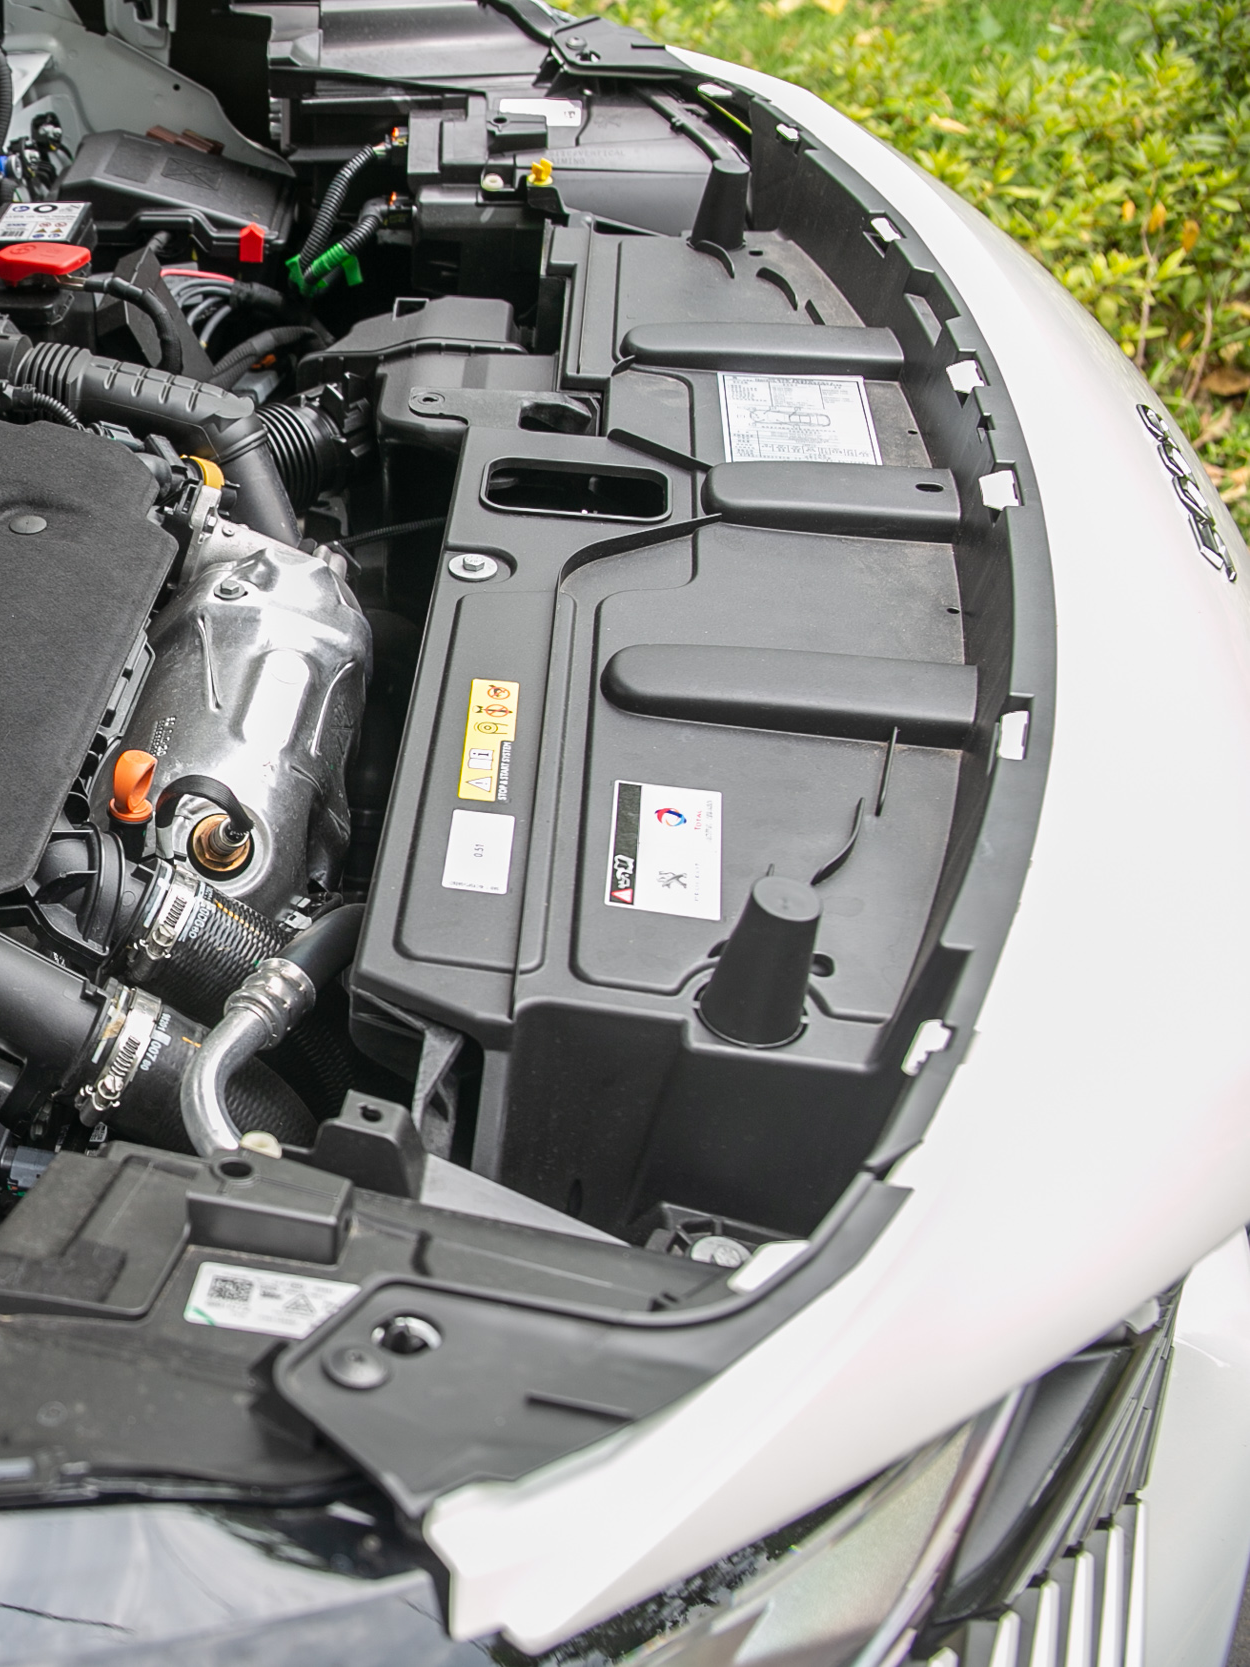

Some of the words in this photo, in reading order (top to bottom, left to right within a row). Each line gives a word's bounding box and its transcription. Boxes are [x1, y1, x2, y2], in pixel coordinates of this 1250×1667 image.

[501, 741, 512, 762] SYSTEM
[499, 761, 511, 780] START
[497, 785, 508, 801] STOP
[694, 810, 702, 830] TOTAL
[145, 1040, 162, 1062] 007
